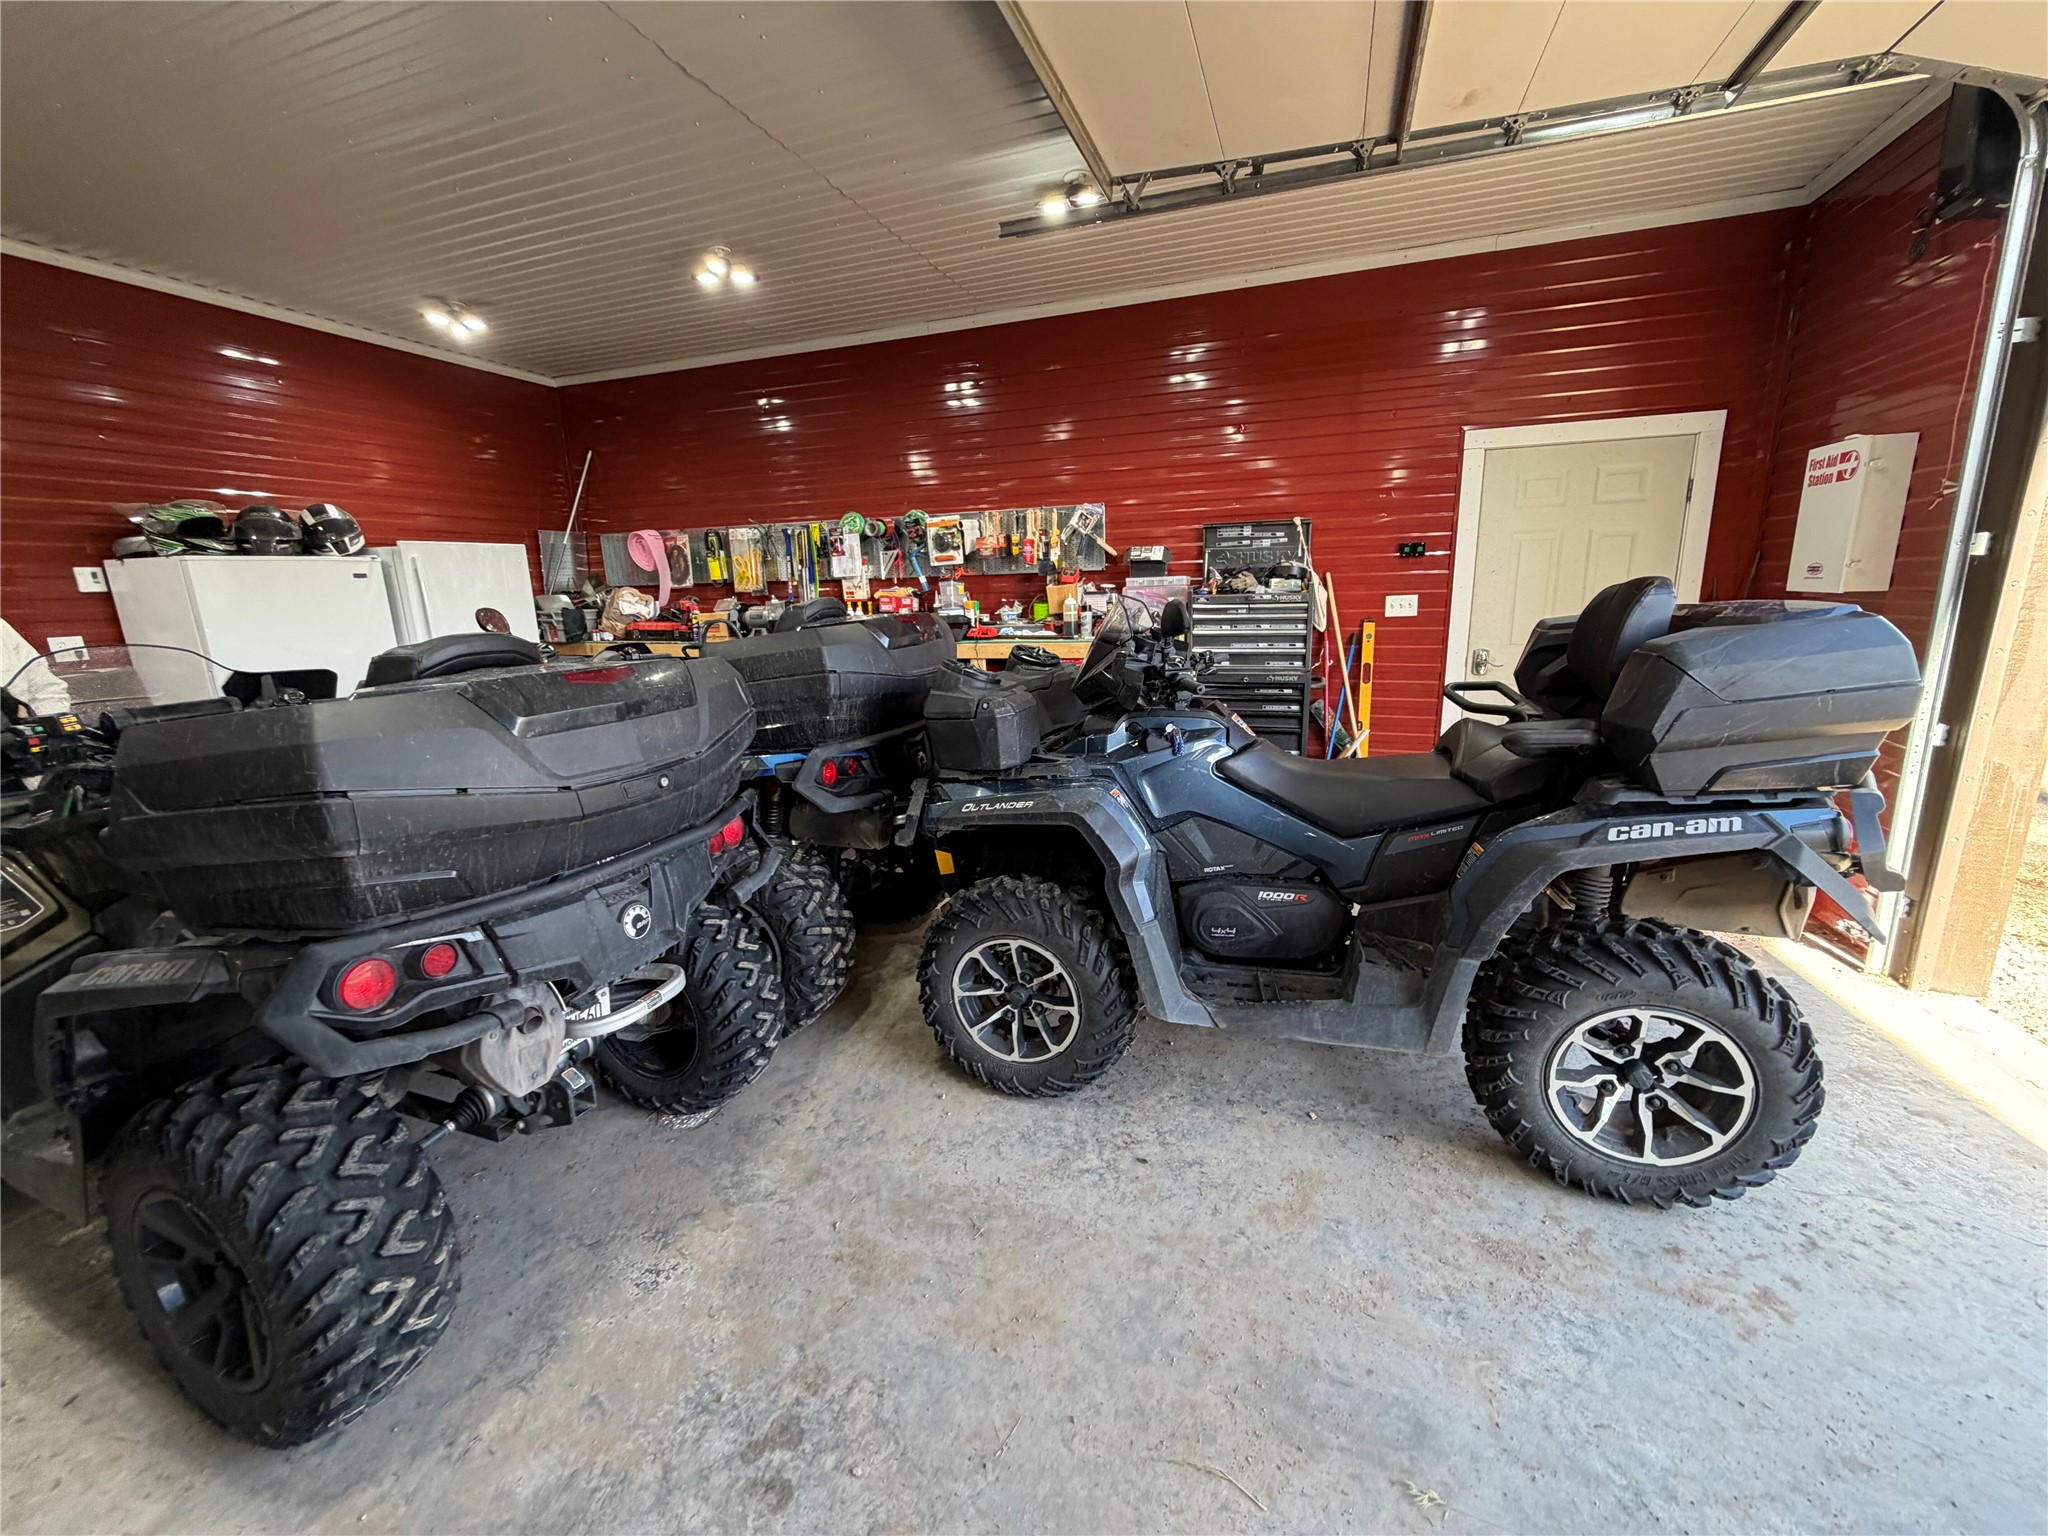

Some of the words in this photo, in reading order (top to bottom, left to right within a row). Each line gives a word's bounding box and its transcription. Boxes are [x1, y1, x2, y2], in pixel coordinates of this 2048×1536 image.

[1809, 457, 1826, 472] First
[1825, 453, 1840, 468] Aid
[1808, 472, 1834, 488] Station
[1237, 550, 1298, 565] HUSKY
[961, 801, 1035, 813] OUTLANDER
[1430, 824, 1464, 837] LIMITED
[1607, 816, 1744, 842] can-am
[1258, 891, 1308, 901] 1000R
[80, 959, 197, 986] can-am
